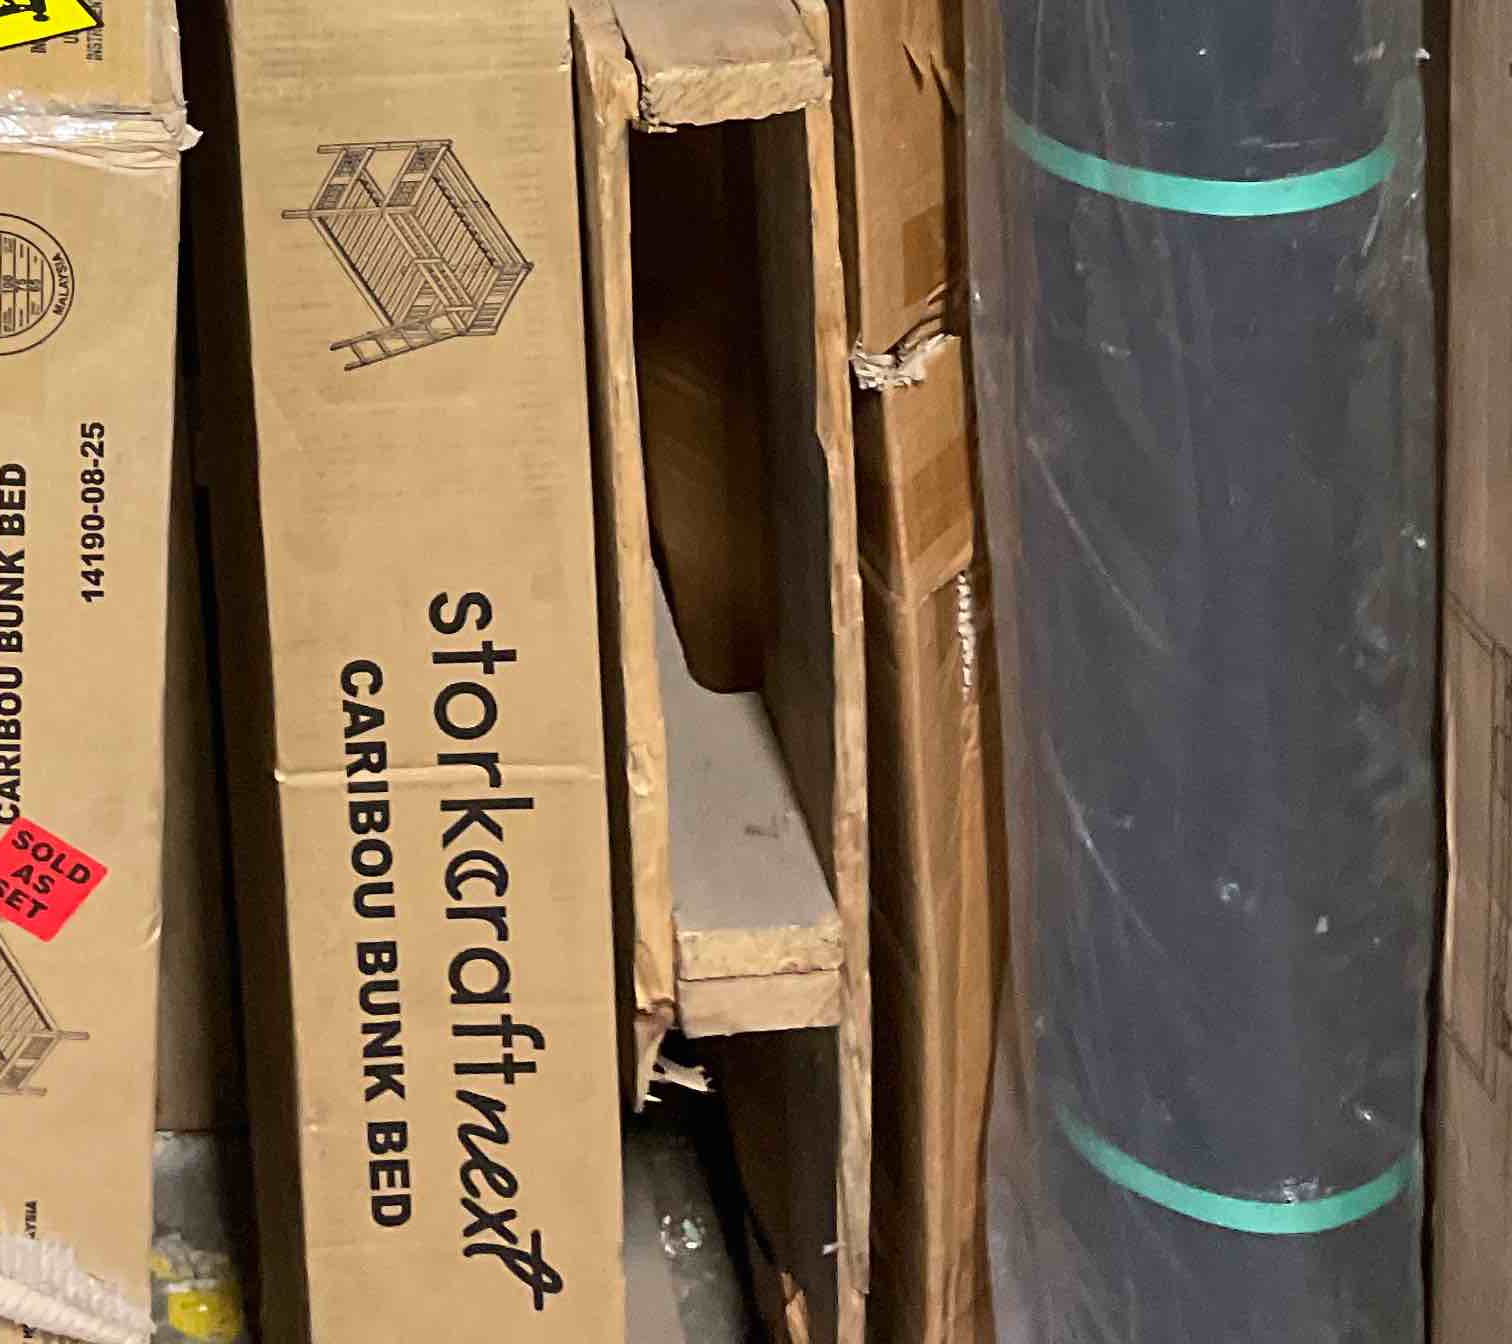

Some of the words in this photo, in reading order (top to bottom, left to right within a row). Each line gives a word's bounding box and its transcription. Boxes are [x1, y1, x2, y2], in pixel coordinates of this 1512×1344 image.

[51, 252, 70, 317] MALAYSIA
[79, 422, 105, 603] 14190-08-25
[340, 659, 397, 918] CARIBOU
[9, 864, 56, 894] AS
[11, 829, 91, 884] SOLD
[355, 940, 406, 1102] BUNK
[366, 1120, 412, 1227] BED
